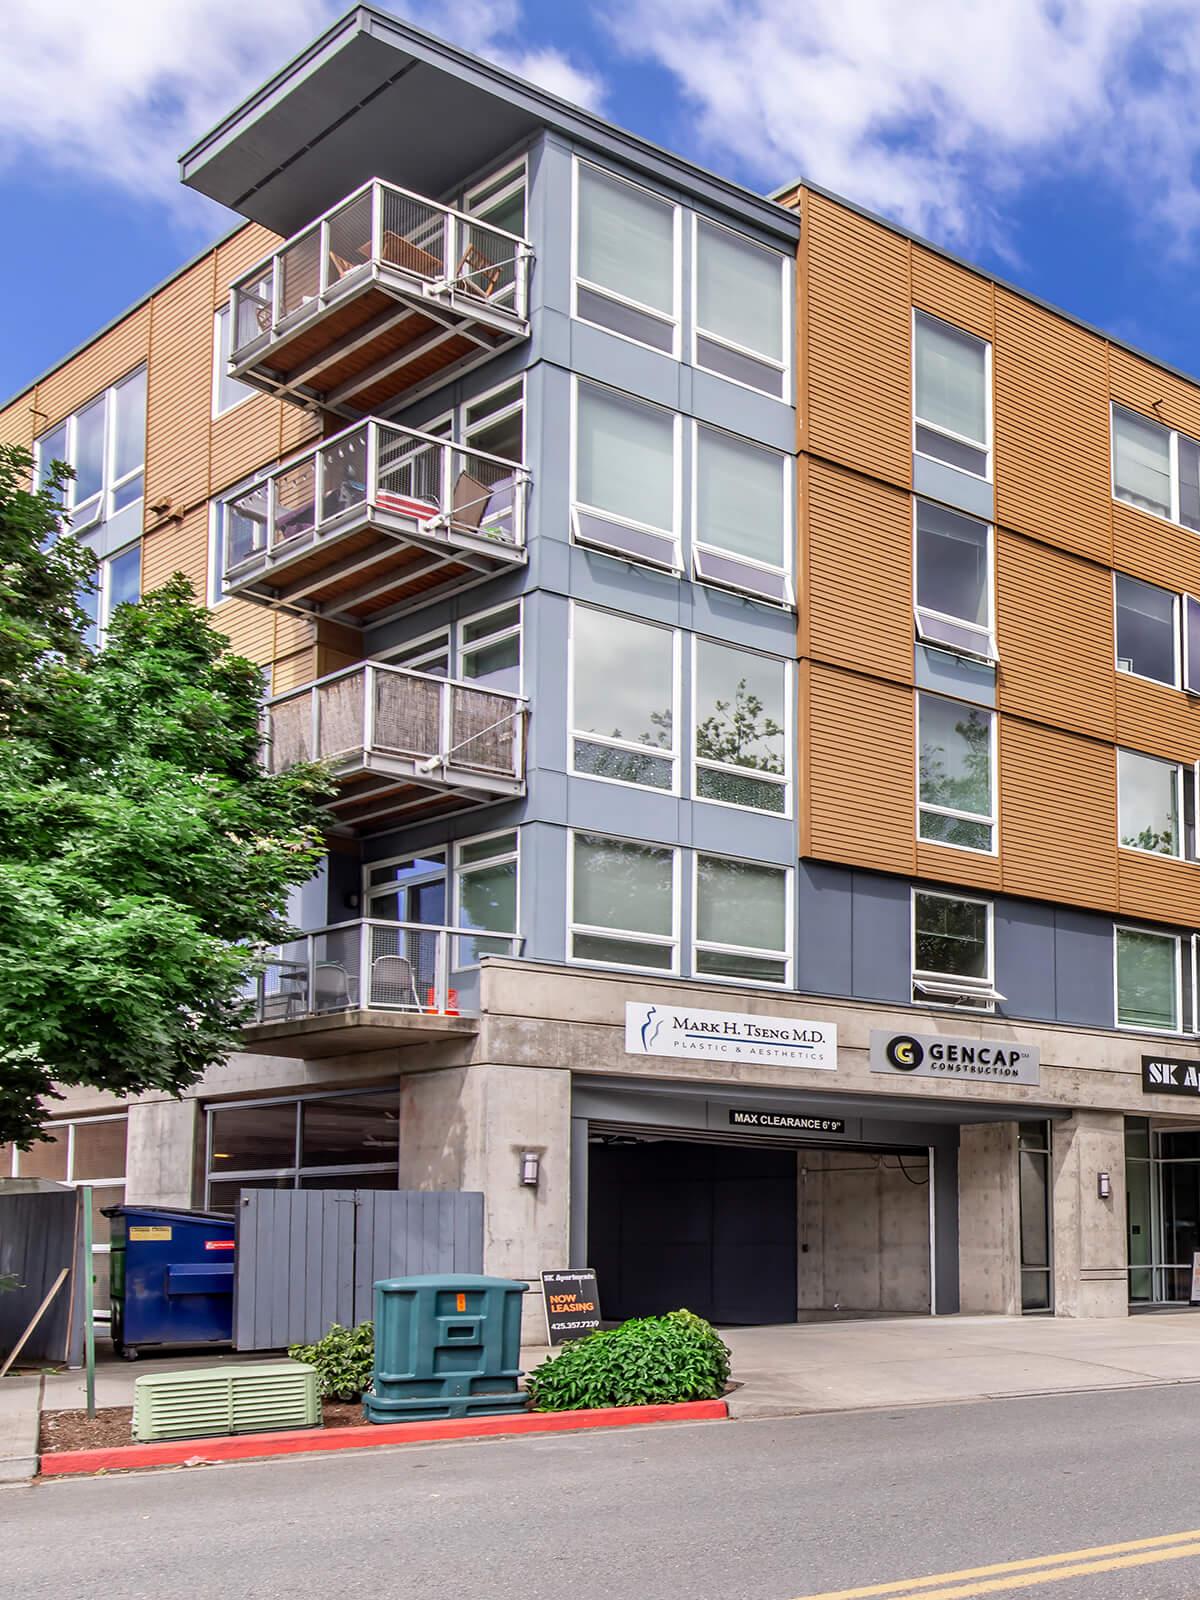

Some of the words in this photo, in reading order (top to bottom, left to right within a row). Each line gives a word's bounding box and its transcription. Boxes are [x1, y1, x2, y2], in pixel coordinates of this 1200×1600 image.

[723, 1021, 741, 1035] H.
[792, 1028, 826, 1044] M.D.
[673, 1040, 728, 1052] PLASTIC
[750, 1047, 825, 1061] AESTHETICS
[928, 1043, 1021, 1067] GENCAP
[930, 1062, 1019, 1077] CONSTRUCTION
[1148, 1062, 1179, 1086] SK
[734, 1112, 758, 1124] MAX
[760, 1115, 821, 1129] CLEARANCE
[549, 1294, 577, 1303] NOW
[551, 1303, 594, 1313] LEASING
